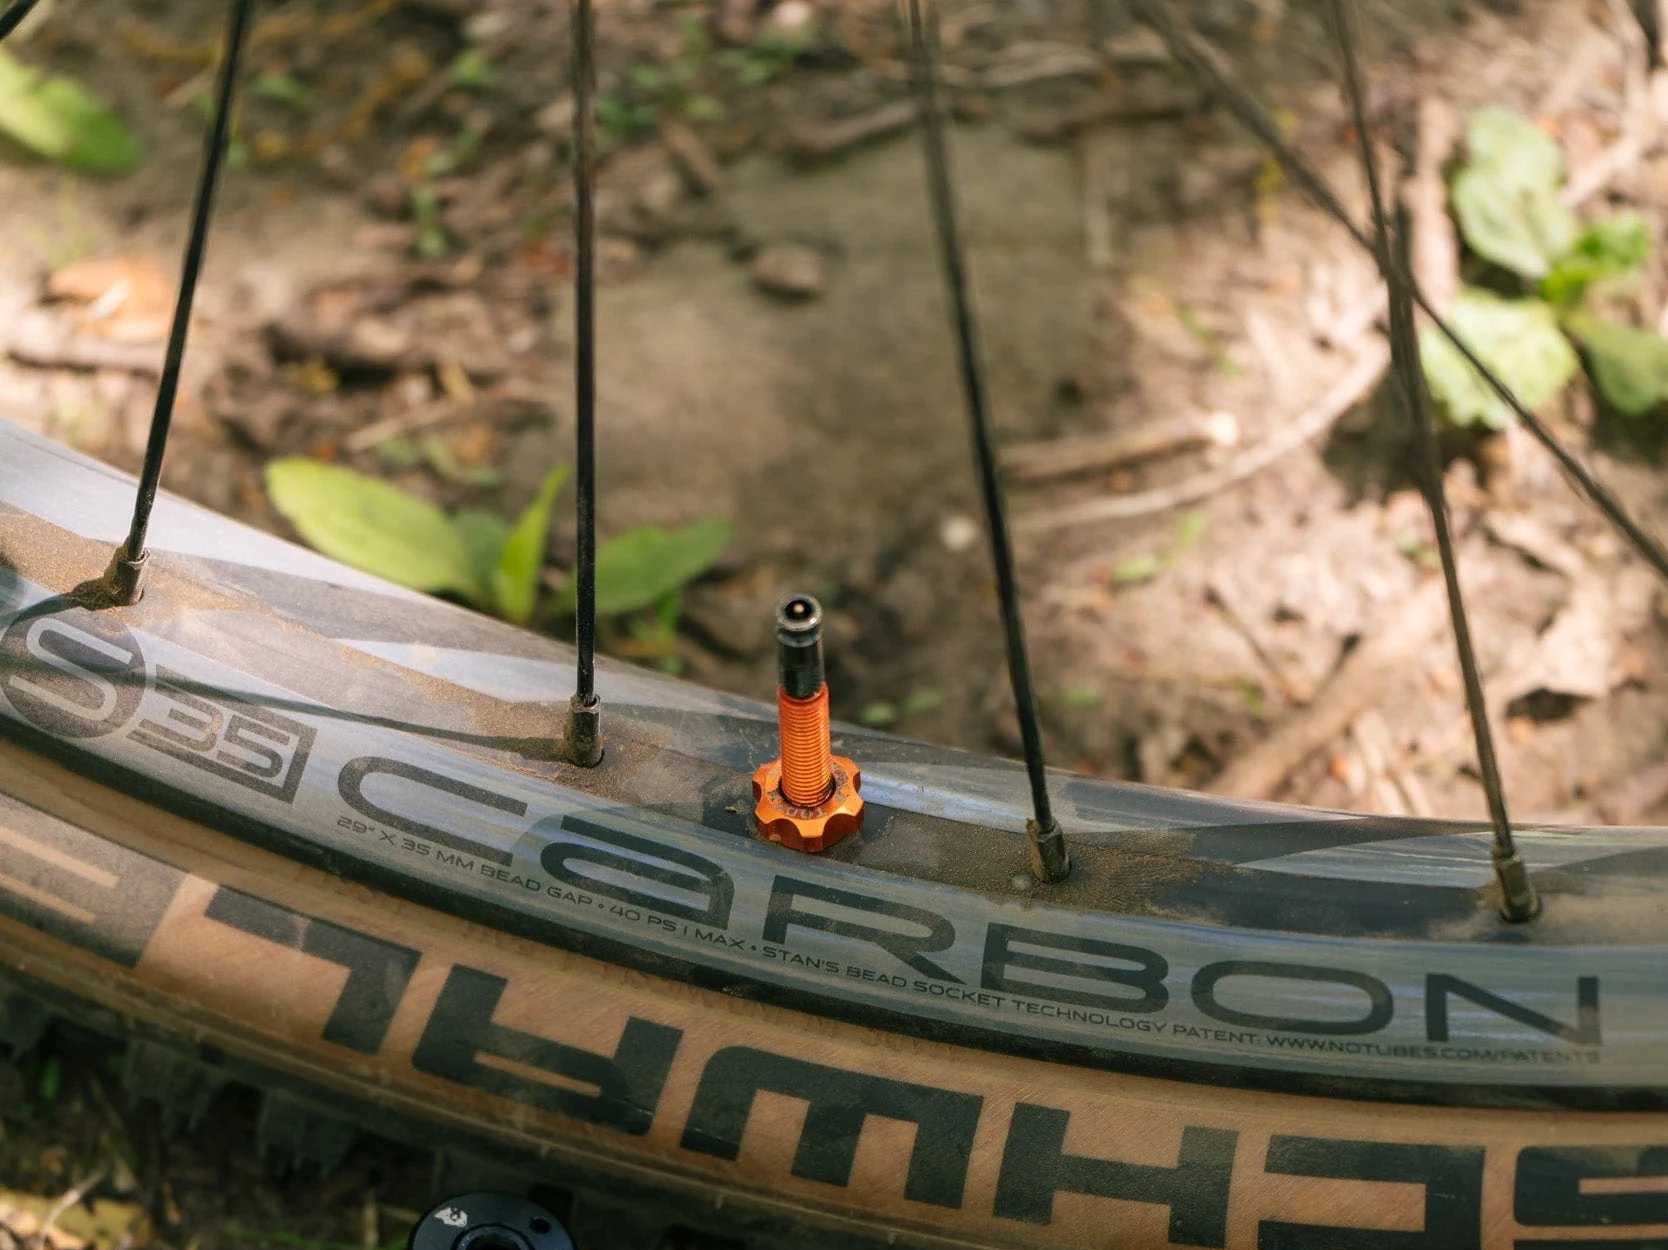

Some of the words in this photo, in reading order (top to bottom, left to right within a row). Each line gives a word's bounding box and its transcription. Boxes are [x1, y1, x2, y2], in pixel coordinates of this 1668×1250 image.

[379, 831, 397, 845] X
[400, 839, 430, 855] 35
[436, 851, 474, 872] MM
[481, 866, 541, 892] BEAD
[547, 887, 593, 905] GAP
[609, 903, 641, 920] 40
[695, 929, 746, 950] MAX
[762, 947, 839, 973] STAN'S
[846, 966, 907, 988] BEAD
[914, 980, 1006, 1007] SOCKET
[1012, 1000, 1167, 1034] TECHNOLOGY
